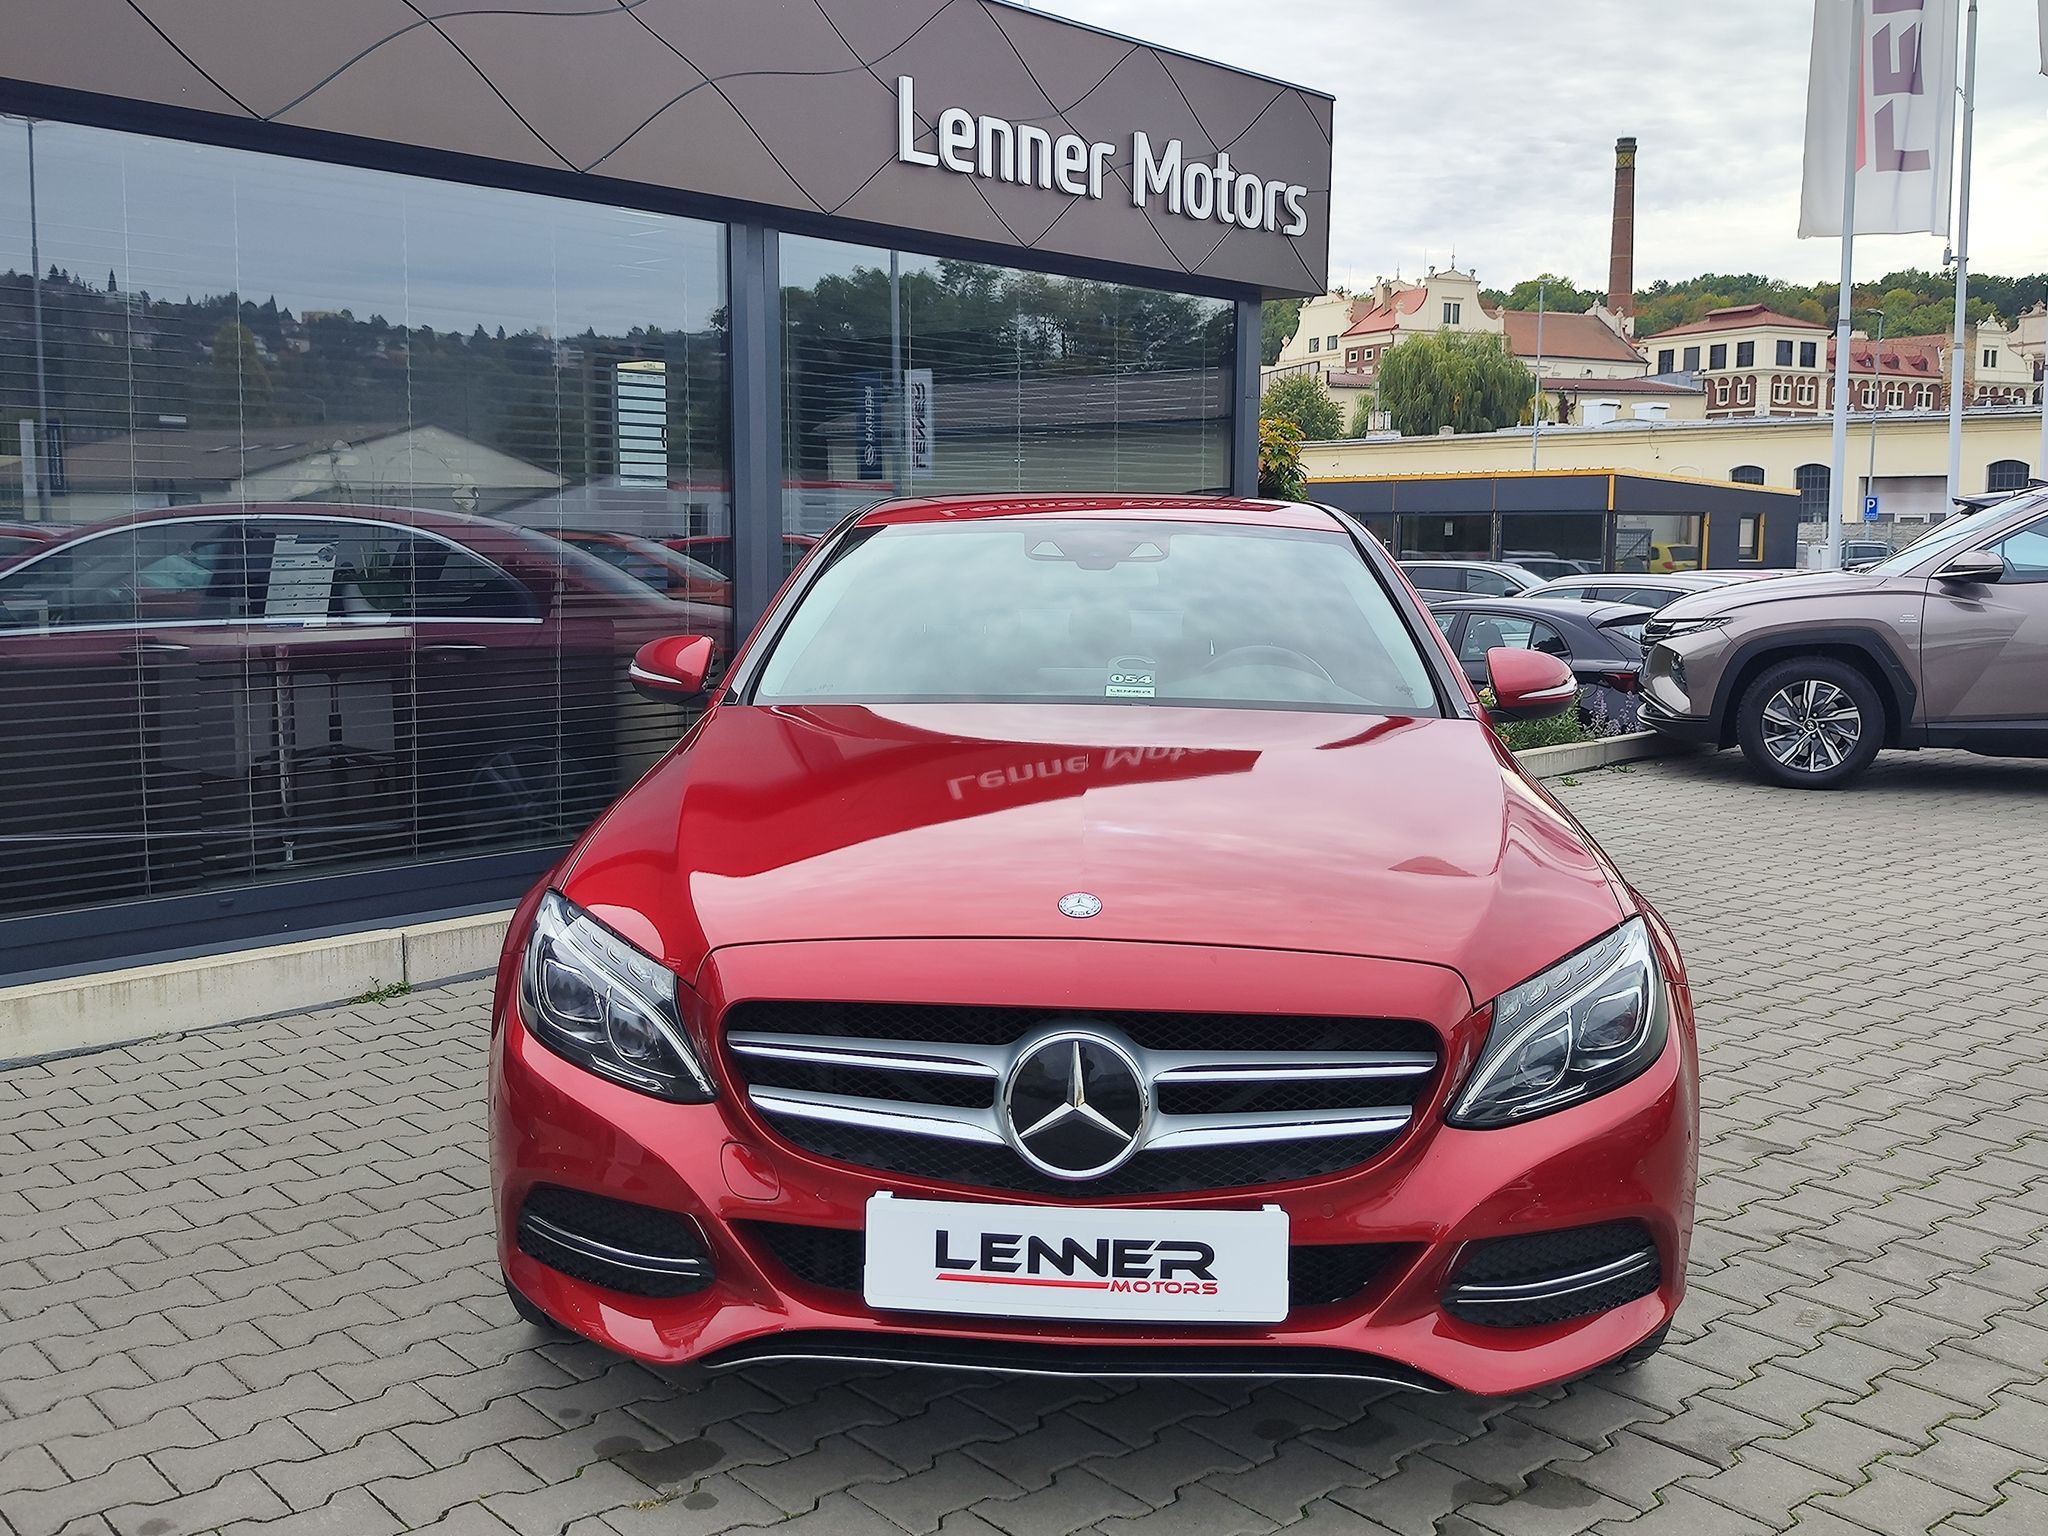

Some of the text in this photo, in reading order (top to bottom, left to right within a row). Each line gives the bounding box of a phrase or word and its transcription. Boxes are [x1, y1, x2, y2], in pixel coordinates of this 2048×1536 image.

[897, 75, 1308, 237] Lenner Motors
[1866, 498, 1876, 513] P
[1109, 673, 1153, 685] 054
[935, 1229, 1217, 1281] LENNER
[1110, 1279, 1218, 1295] MOTORS
